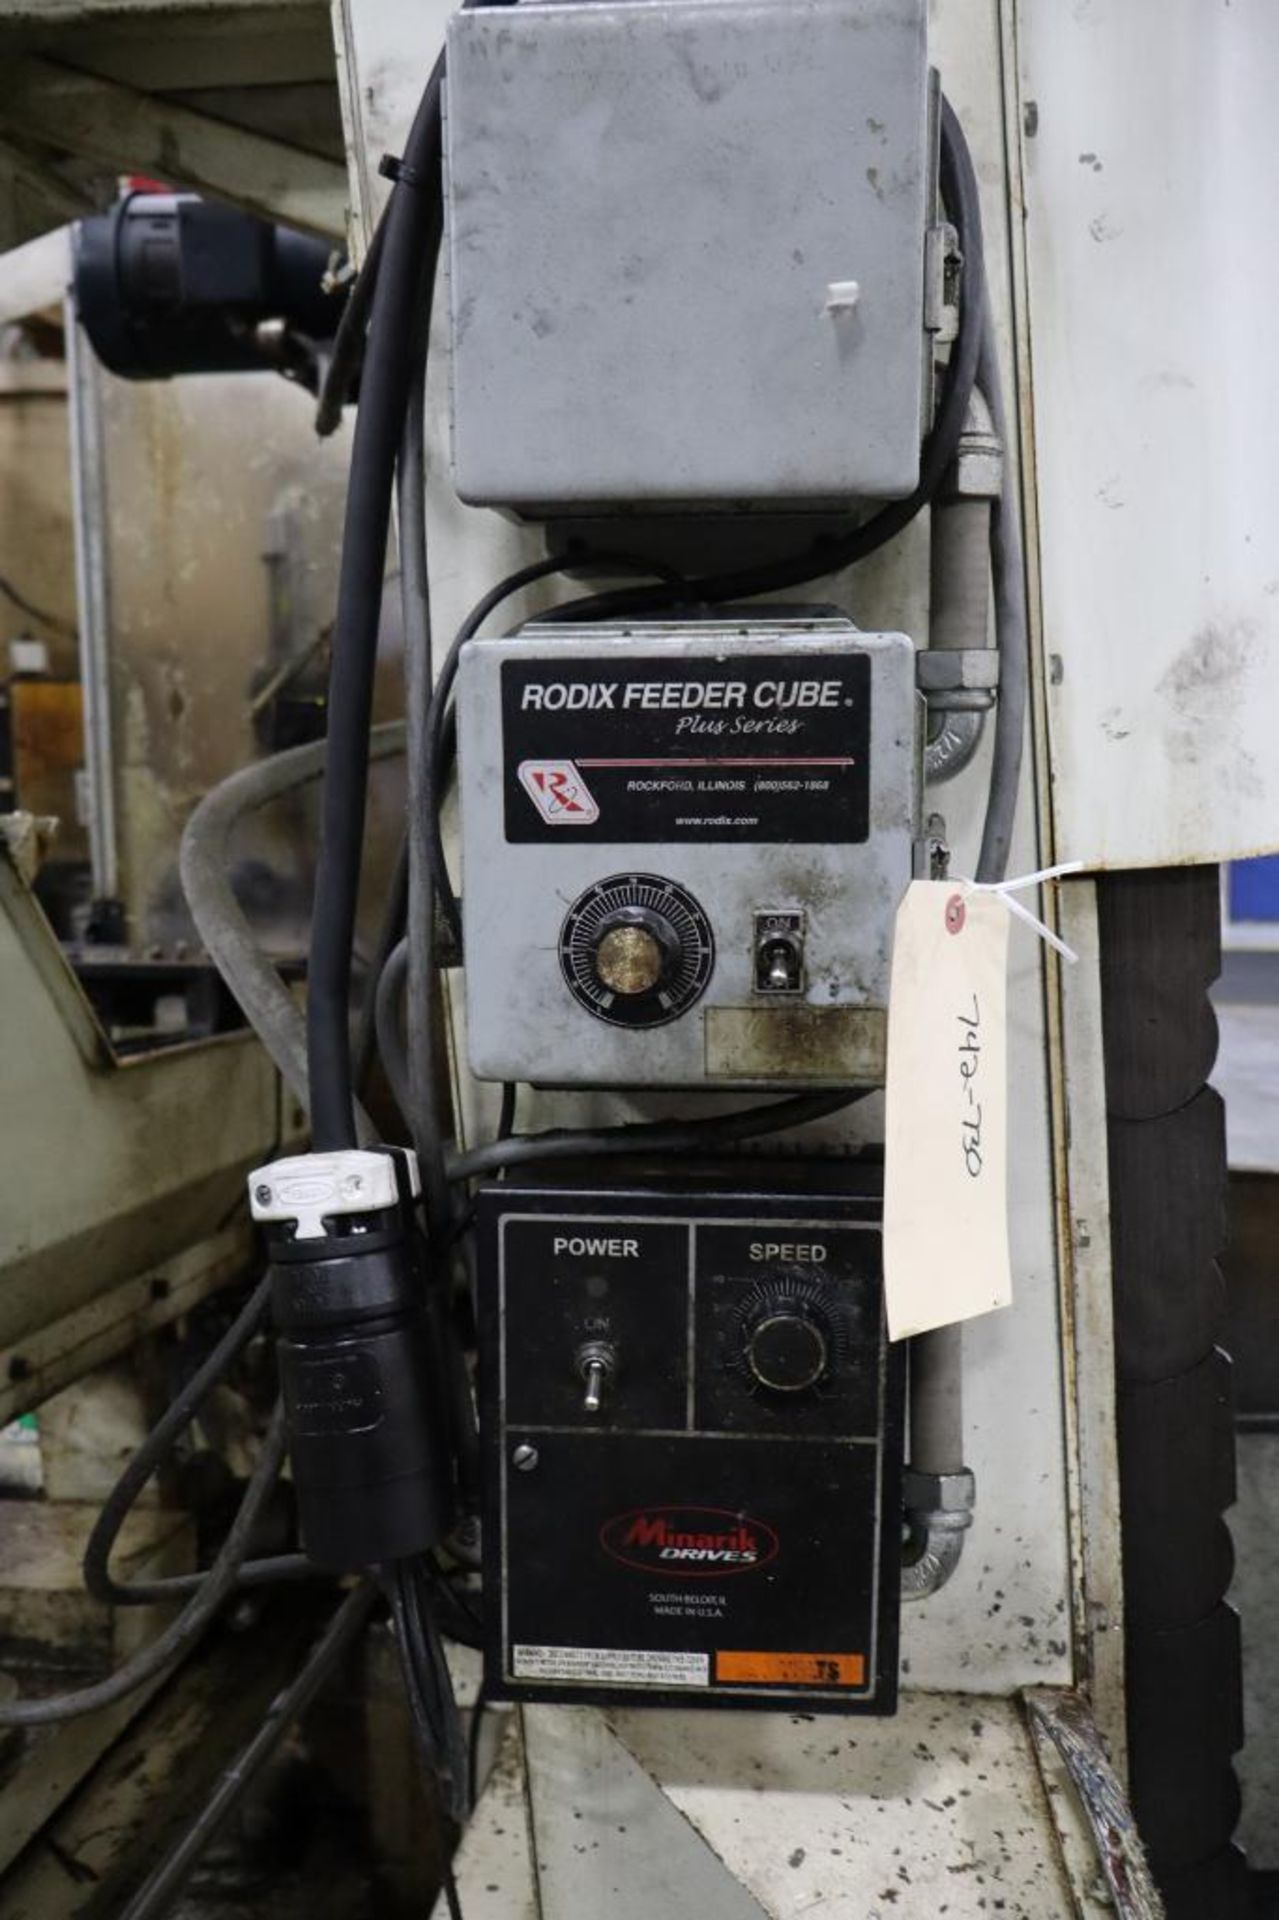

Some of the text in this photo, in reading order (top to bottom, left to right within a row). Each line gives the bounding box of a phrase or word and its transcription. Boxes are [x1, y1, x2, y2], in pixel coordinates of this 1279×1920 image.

[521, 683, 618, 710] RODIX
[622, 682, 748, 709] FEEDER
[674, 715, 804, 735] Plus Series
[698, 780, 746, 792] ILLINOIS
[674, 815, 759, 827] www.rodix.com
[553, 1237, 640, 1258] POWER
[749, 1243, 828, 1263] SPEED
[625, 1516, 758, 1551] Minarik
[658, 1547, 758, 1563] DRIVES
[648, 1593, 683, 1604] SOUTH
[654, 1606, 683, 1616] MADE
[685, 1606, 696, 1617] IN
